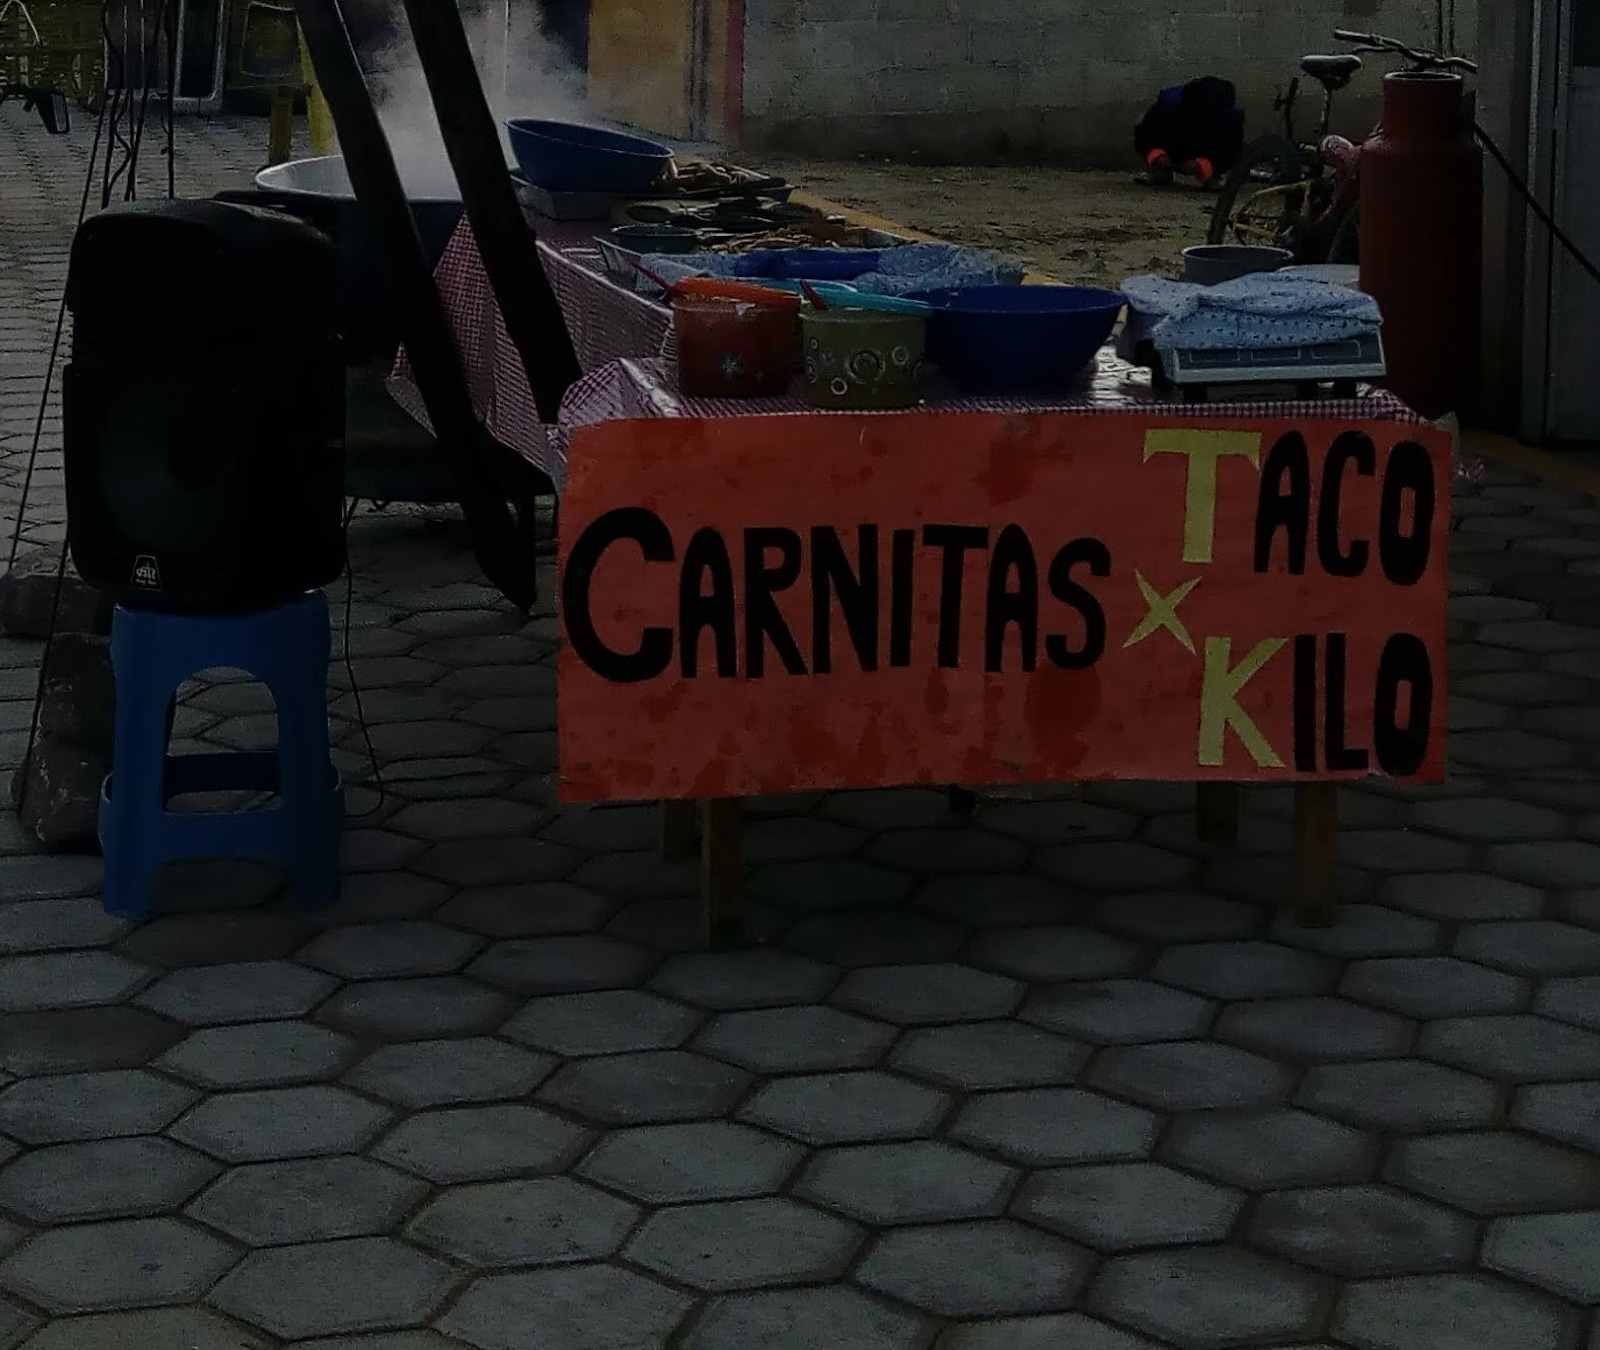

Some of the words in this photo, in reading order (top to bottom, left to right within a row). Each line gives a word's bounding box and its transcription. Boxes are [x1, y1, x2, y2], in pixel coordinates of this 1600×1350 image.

[1142, 427, 1436, 586] TACO
[562, 505, 1112, 683] CARNITAS
[1198, 633, 1434, 776] KILO
